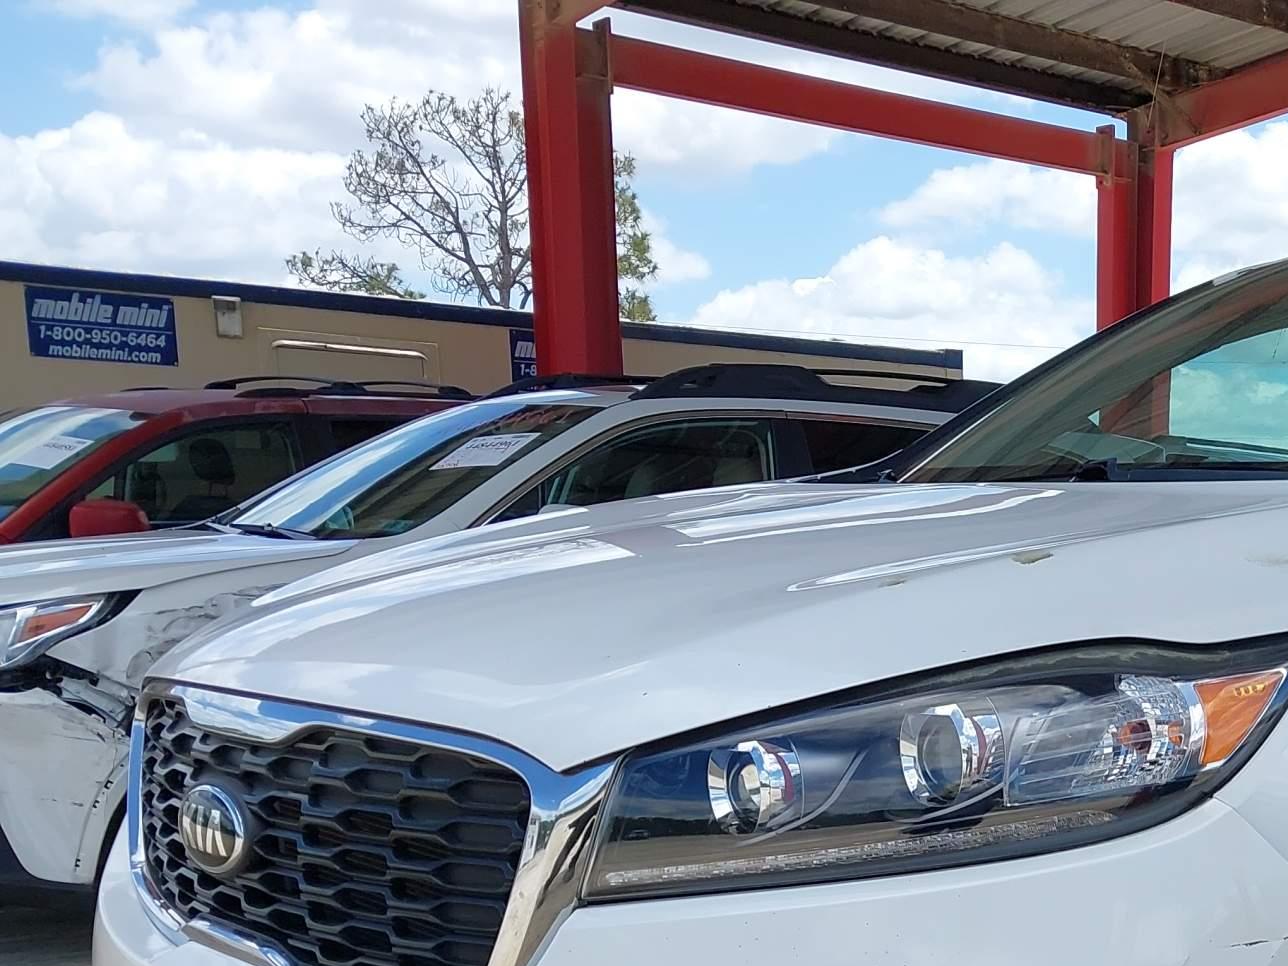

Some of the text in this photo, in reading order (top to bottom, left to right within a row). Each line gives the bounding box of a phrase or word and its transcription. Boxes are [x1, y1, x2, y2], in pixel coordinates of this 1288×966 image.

[31, 292, 169, 328] mobile mini
[39, 325, 166, 348] 1-800-950-6464
[48, 343, 161, 363] mobilemini.com
[181, 801, 228, 857] KIA
